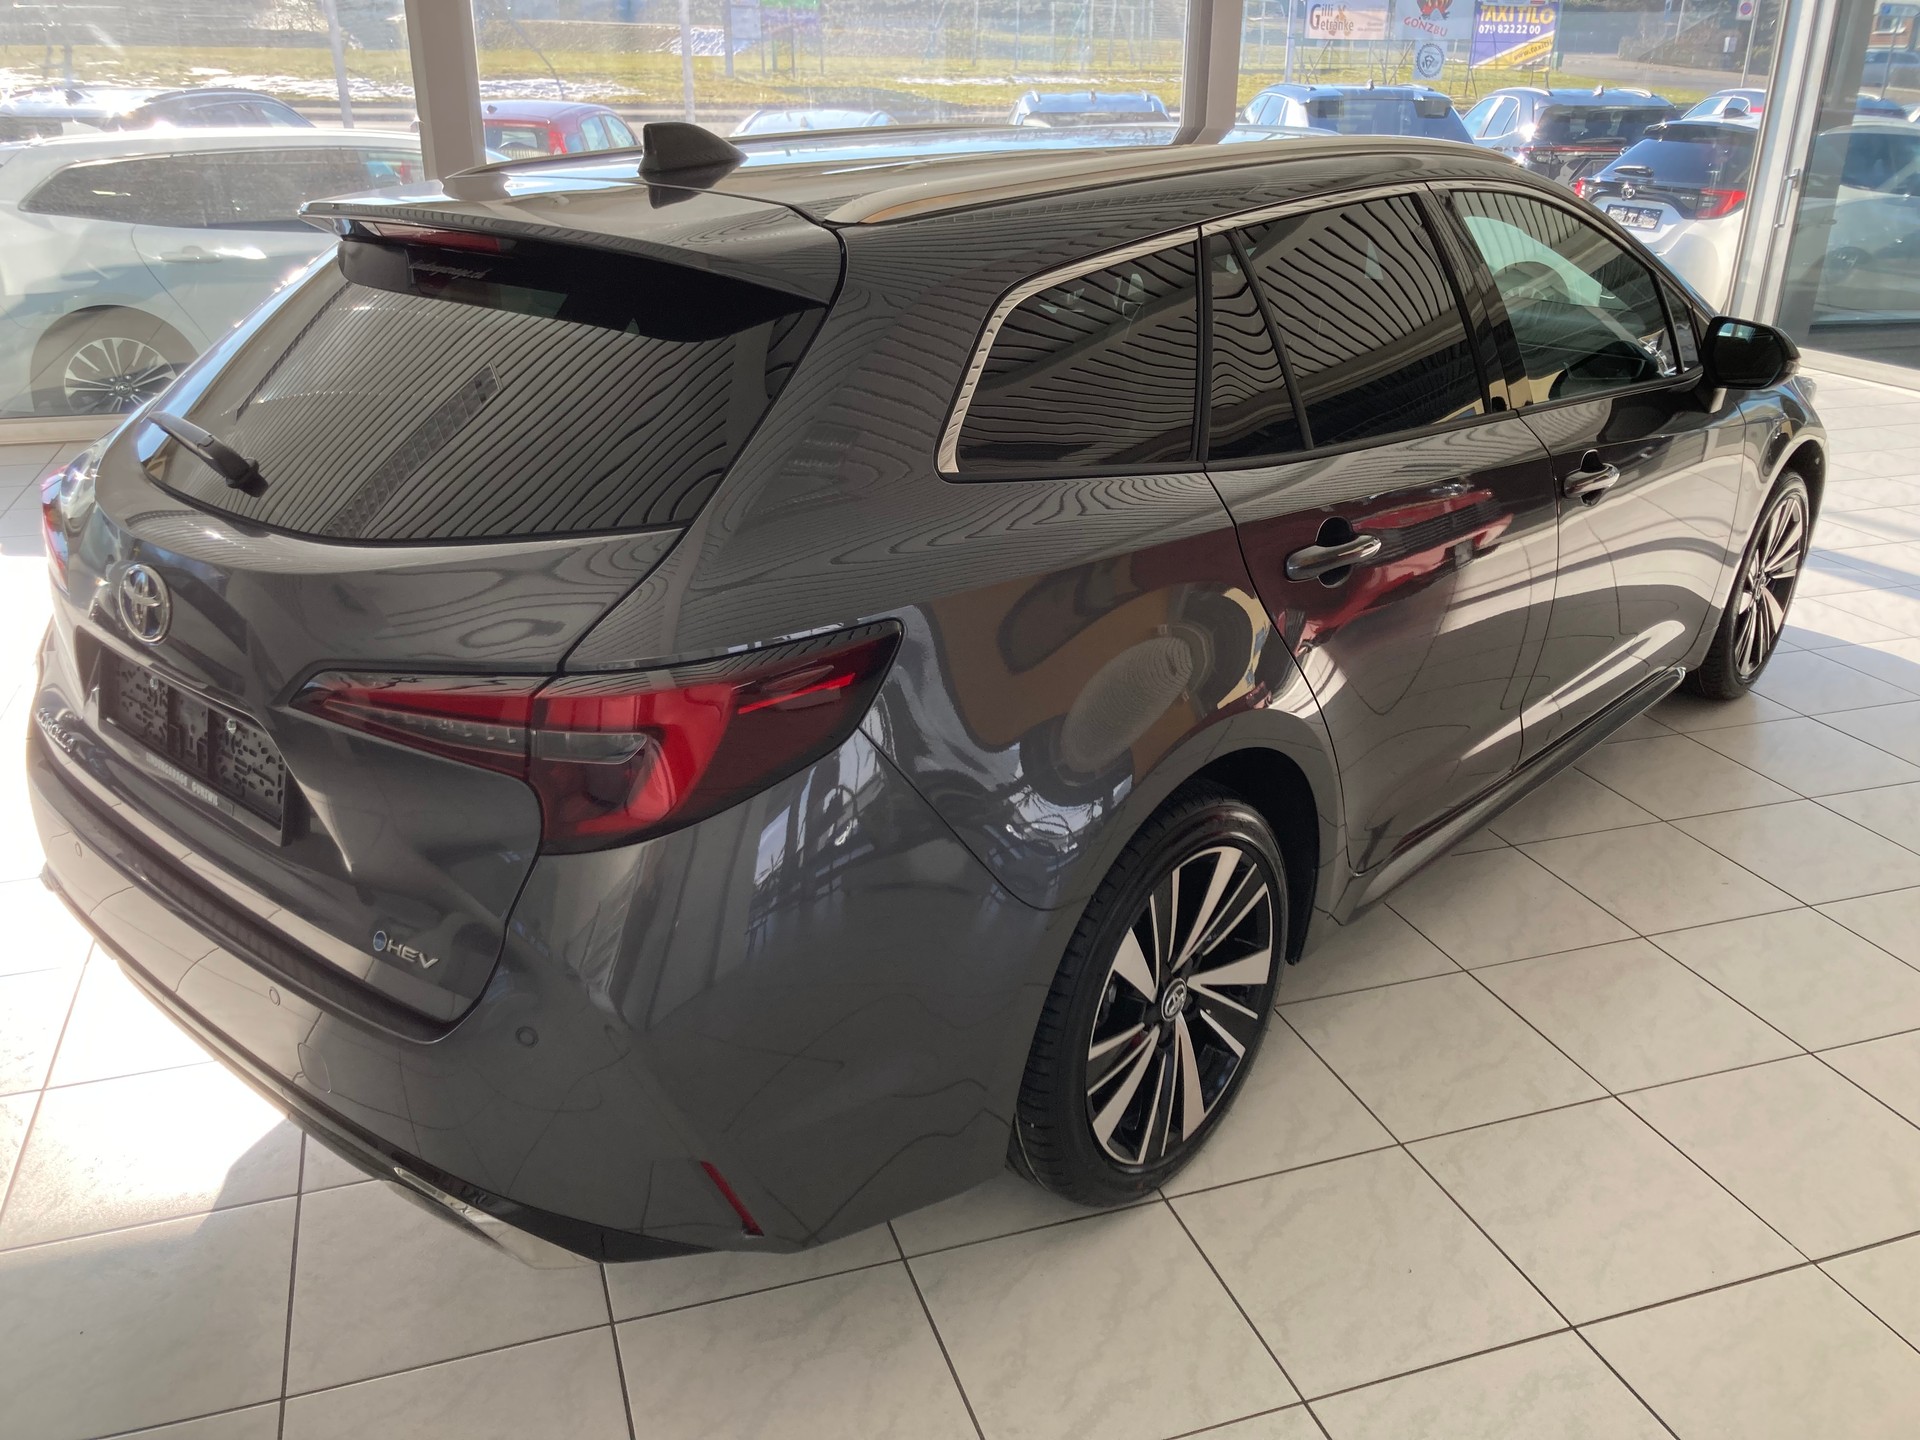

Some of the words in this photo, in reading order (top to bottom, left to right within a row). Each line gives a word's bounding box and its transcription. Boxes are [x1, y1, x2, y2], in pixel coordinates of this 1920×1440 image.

[1309, 4, 1334, 30] Gilli
[1480, 5, 1514, 22] TAXI
[1517, 7, 1556, 24] TILO
[1403, 16, 1448, 37] GONZBU
[1478, 24, 1495, 34] 079
[1497, 24, 1515, 34] 822
[1516, 24, 1528, 34] 22
[1529, 25, 1541, 34] 00
[386, 939, 439, 969] HEV
